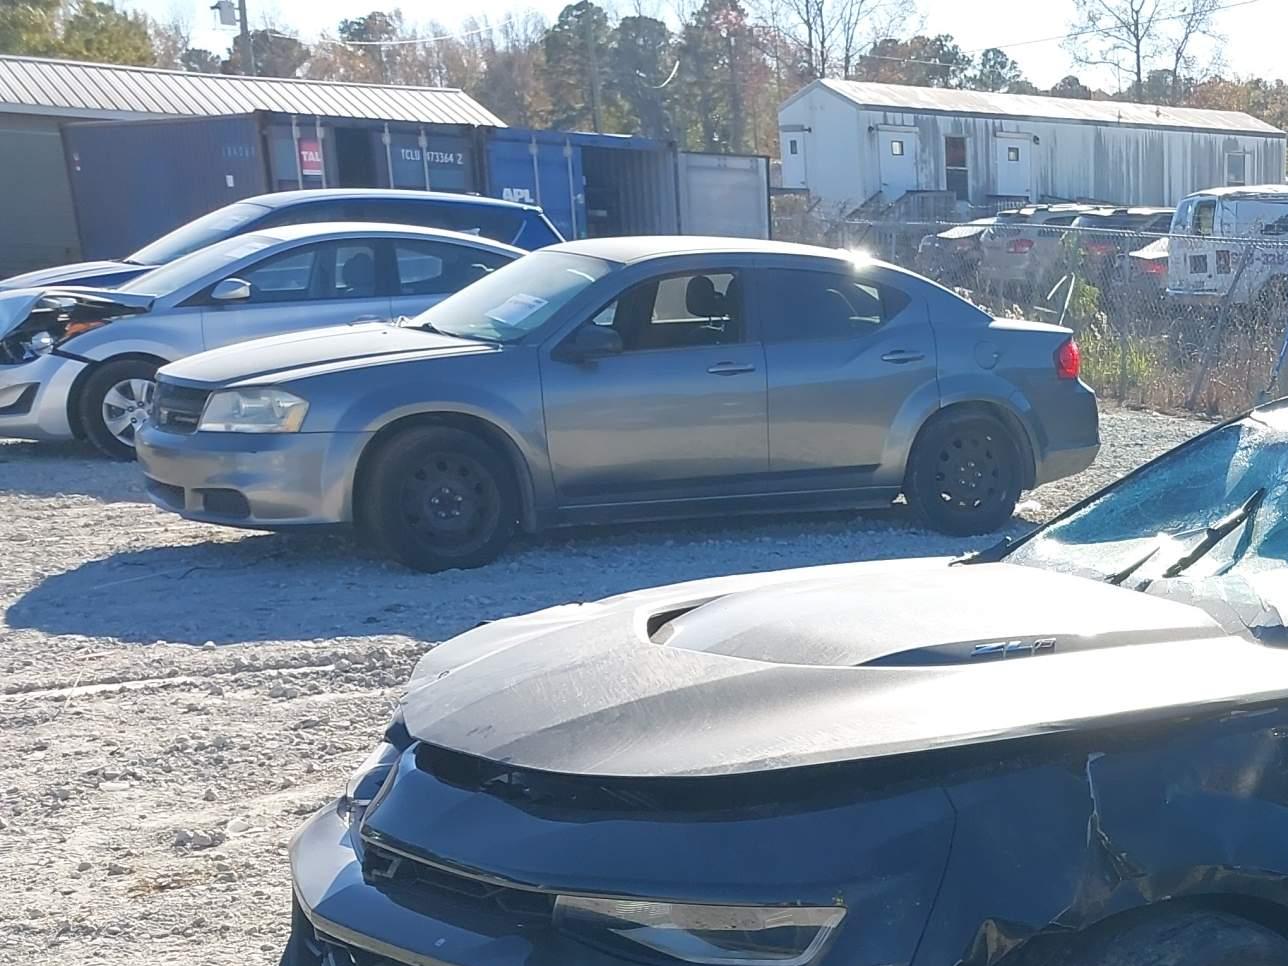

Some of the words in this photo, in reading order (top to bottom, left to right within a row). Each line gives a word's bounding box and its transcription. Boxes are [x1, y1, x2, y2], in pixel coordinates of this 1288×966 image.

[301, 149, 321, 162] TAL
[456, 153, 465, 165] 2
[502, 187, 535, 202] APL
